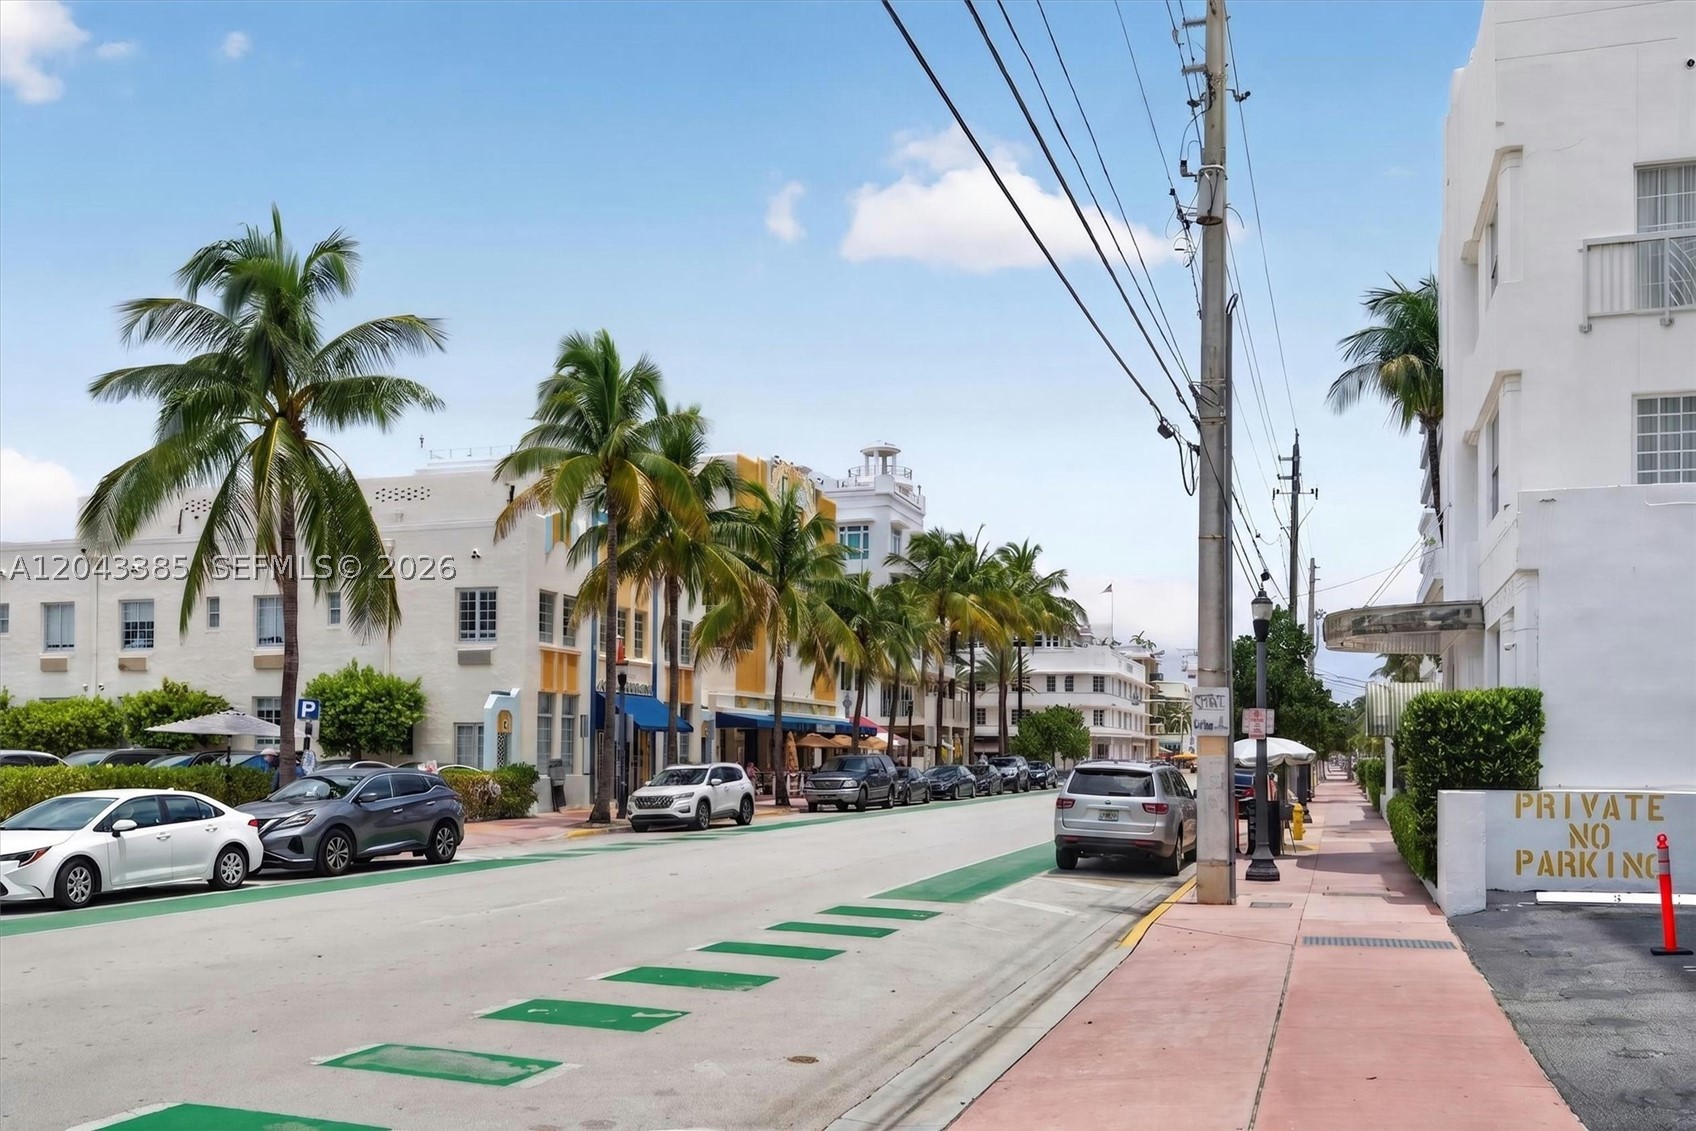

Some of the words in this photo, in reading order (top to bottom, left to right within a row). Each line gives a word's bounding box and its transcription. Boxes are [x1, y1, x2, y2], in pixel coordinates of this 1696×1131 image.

[301, 701, 316, 717] P
[1515, 793, 1665, 821] PRIVATE
[1569, 823, 1610, 850] NO
